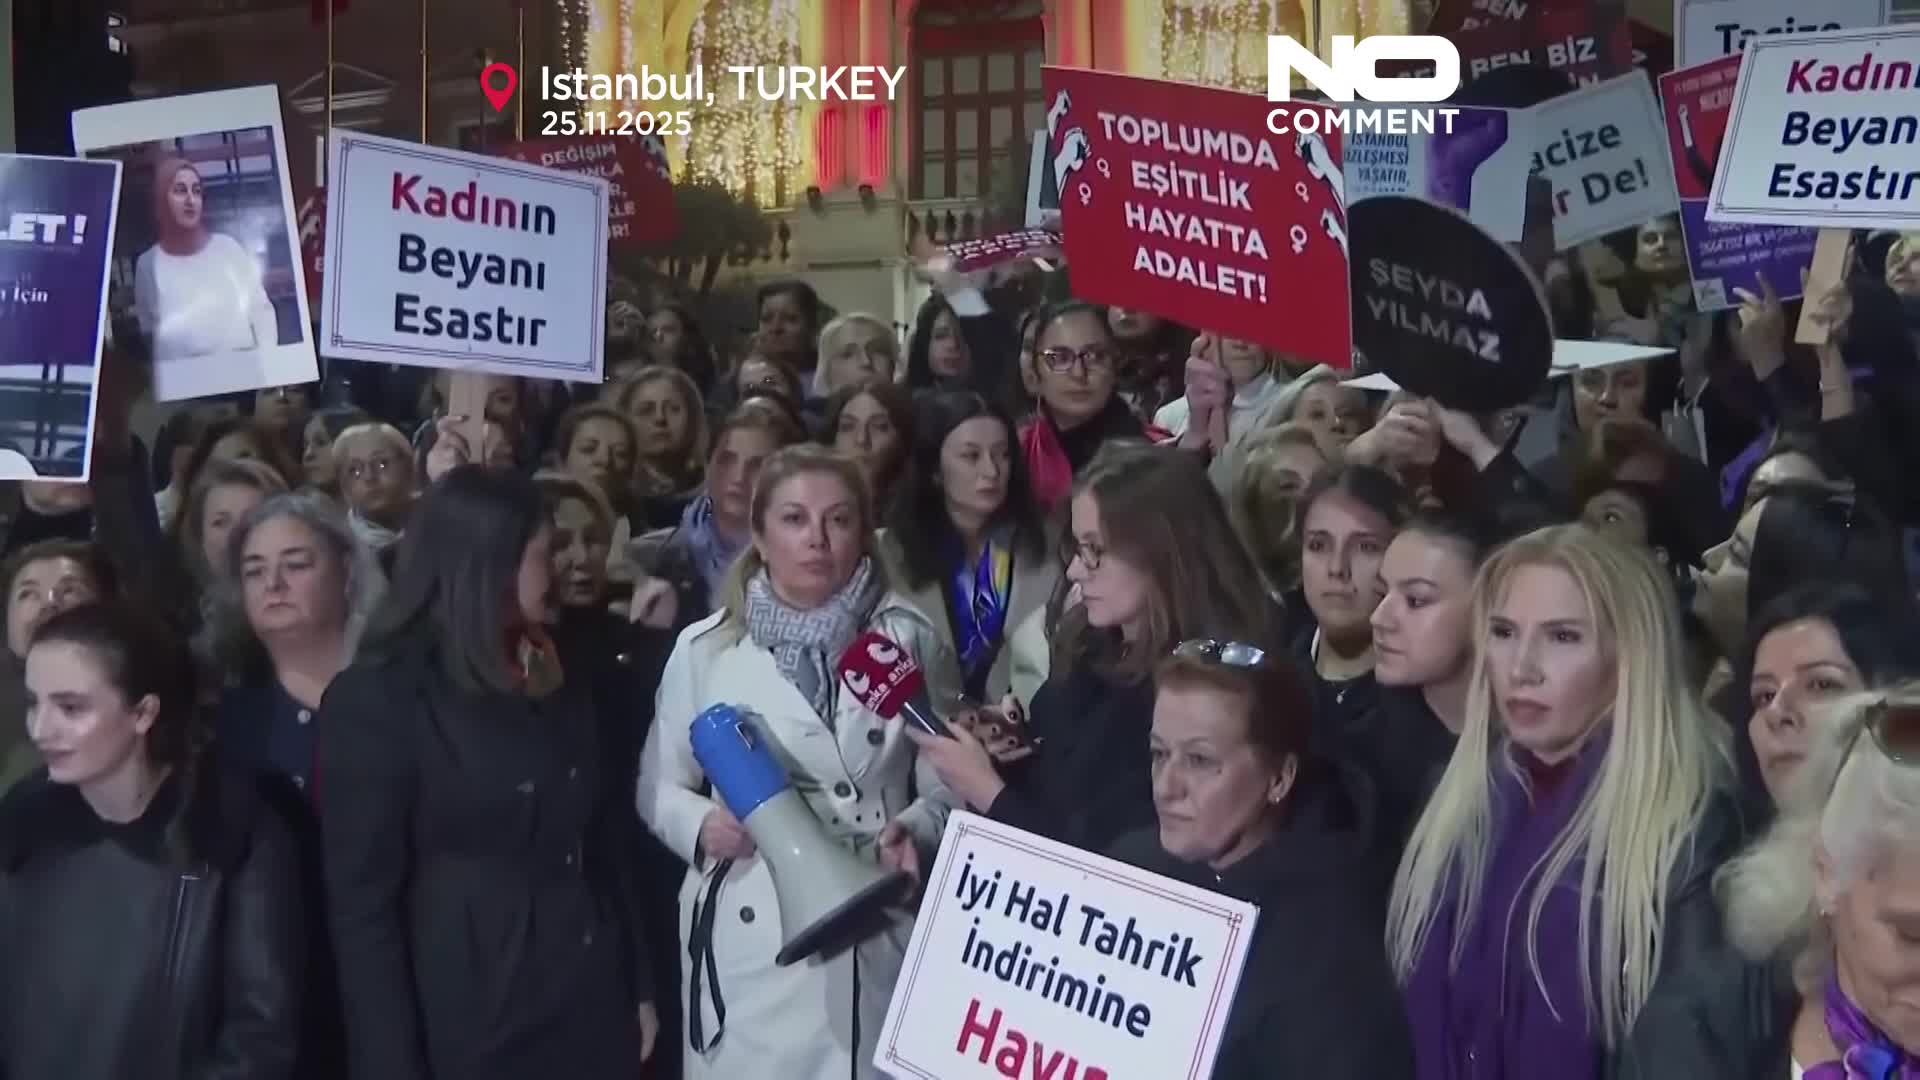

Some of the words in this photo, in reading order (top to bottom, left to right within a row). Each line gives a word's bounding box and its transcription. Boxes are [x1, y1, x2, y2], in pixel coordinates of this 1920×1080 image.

[1547, 35, 1597, 67] BİZ
[1097, 112, 1280, 171] TOPLUMDA
[392, 171, 556, 235] Kadının
[1131, 160, 1252, 212] EŞİTLİK
[1581, 157, 1649, 206] De!
[1124, 201, 1268, 260] HAYATTA
[398, 233, 545, 290] Beyanı
[1133, 245, 1267, 304] ADALET!
[1369, 257, 1492, 321] ŞEYDA
[395, 293, 546, 346] Esastır
[1366, 294, 1500, 362] YILMAZ
[956, 852, 1001, 912] İyi
[1004, 880, 1070, 937] Hal
[1079, 904, 1203, 988] Tahrik
[961, 916, 1151, 1038] İndirimine
